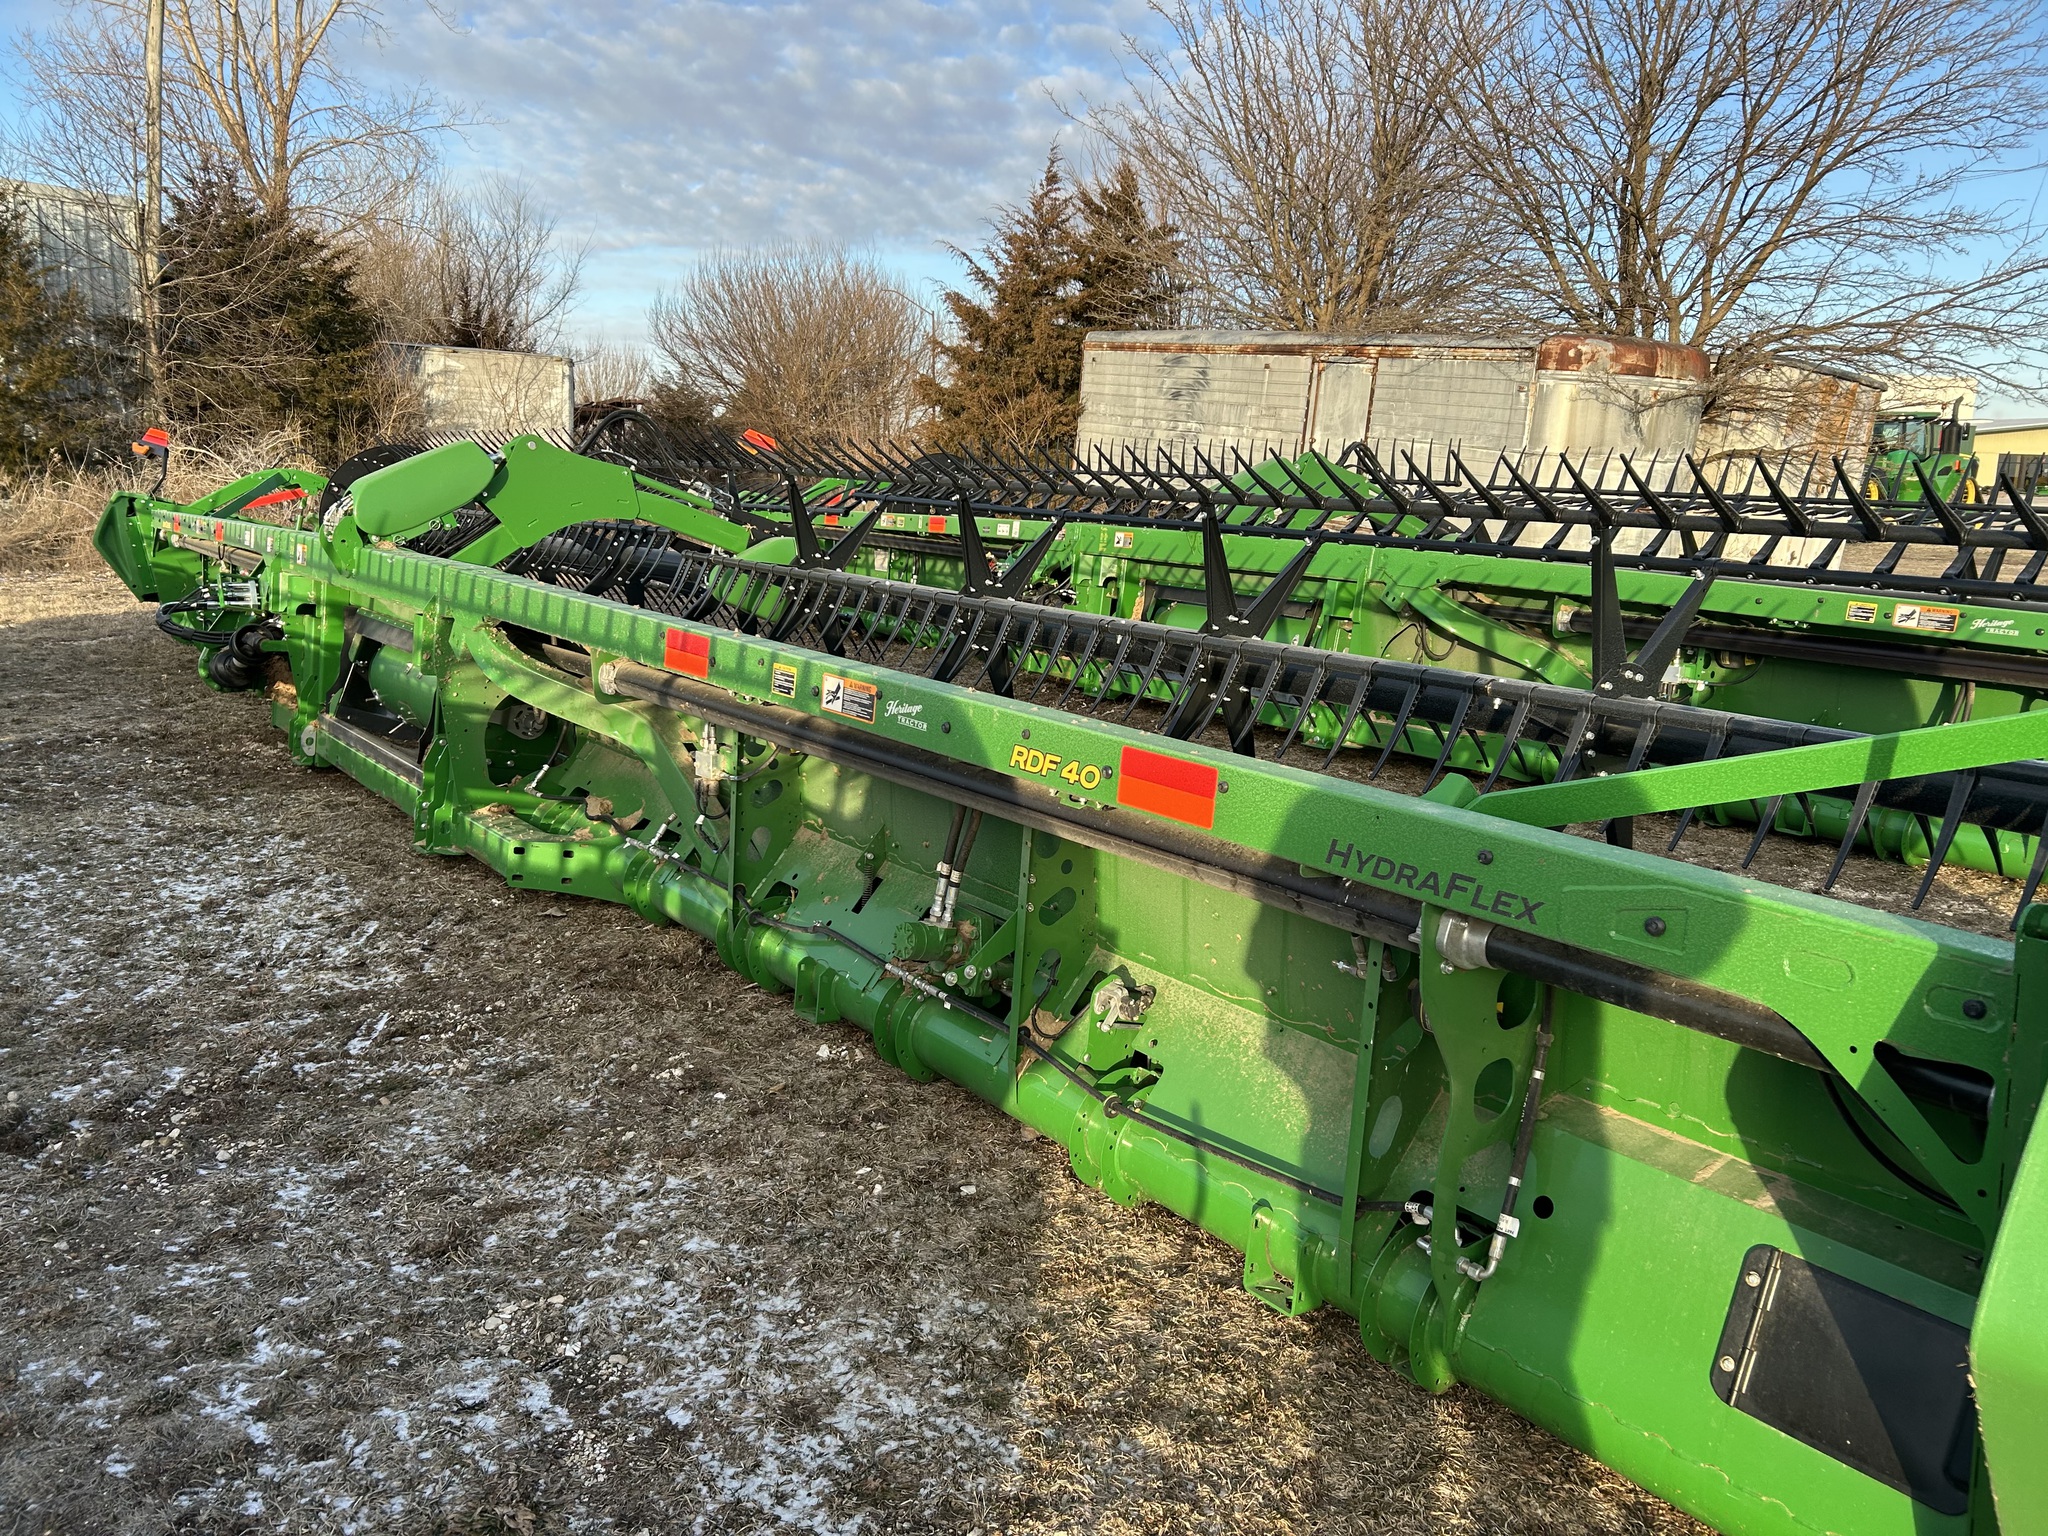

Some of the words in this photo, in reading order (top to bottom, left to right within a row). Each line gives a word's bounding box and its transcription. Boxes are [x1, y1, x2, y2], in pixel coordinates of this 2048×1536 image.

[1970, 618, 2015, 630] Heritage
[1985, 627, 2019, 636] TRACTOR
[853, 681, 872, 692] WARNING
[884, 700, 923, 717] Heritage
[897, 715, 927, 731] TRACTOR
[1009, 744, 1062, 777] RDF
[1060, 760, 1102, 790] 40
